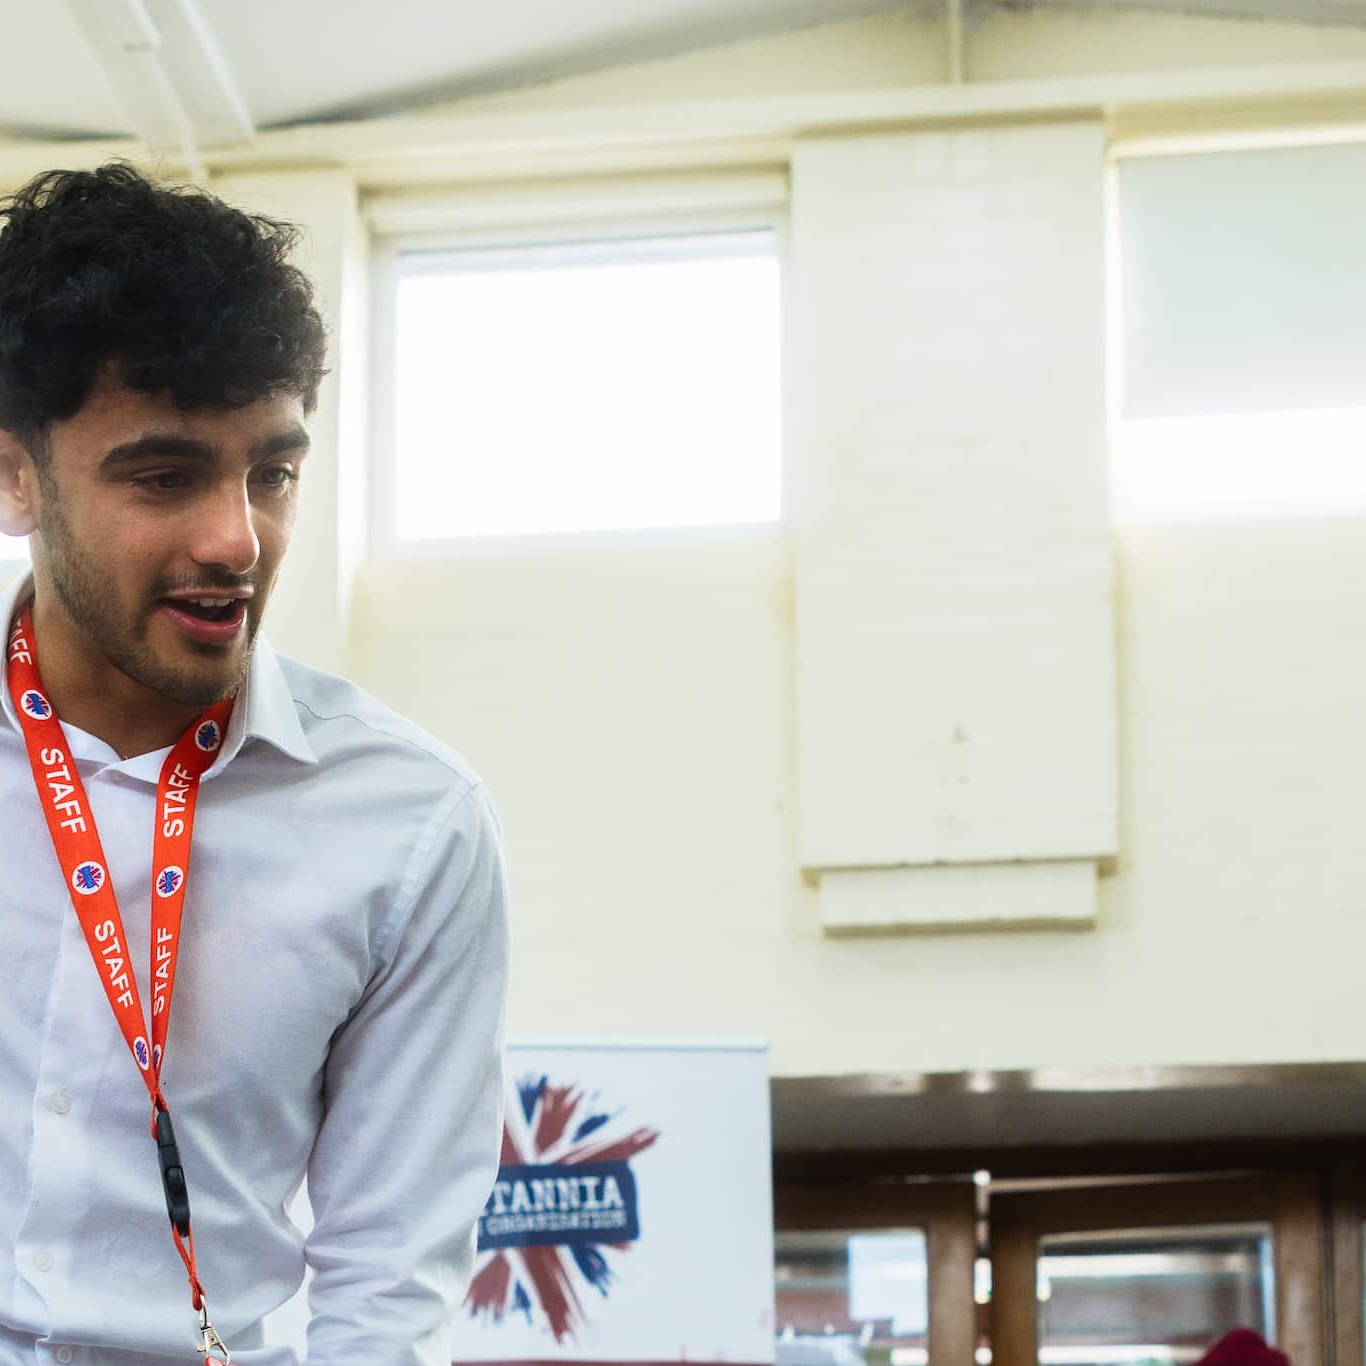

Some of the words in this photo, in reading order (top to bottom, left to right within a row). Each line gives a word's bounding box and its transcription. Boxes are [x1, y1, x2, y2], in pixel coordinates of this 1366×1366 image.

[10, 617, 33, 666] AFF
[40, 747, 86, 834] STAFF
[162, 763, 195, 838] STAFF
[94, 919, 134, 1008] STAFF
[152, 926, 174, 1017] STAFF
[484, 1175, 626, 1215] TANNIA
